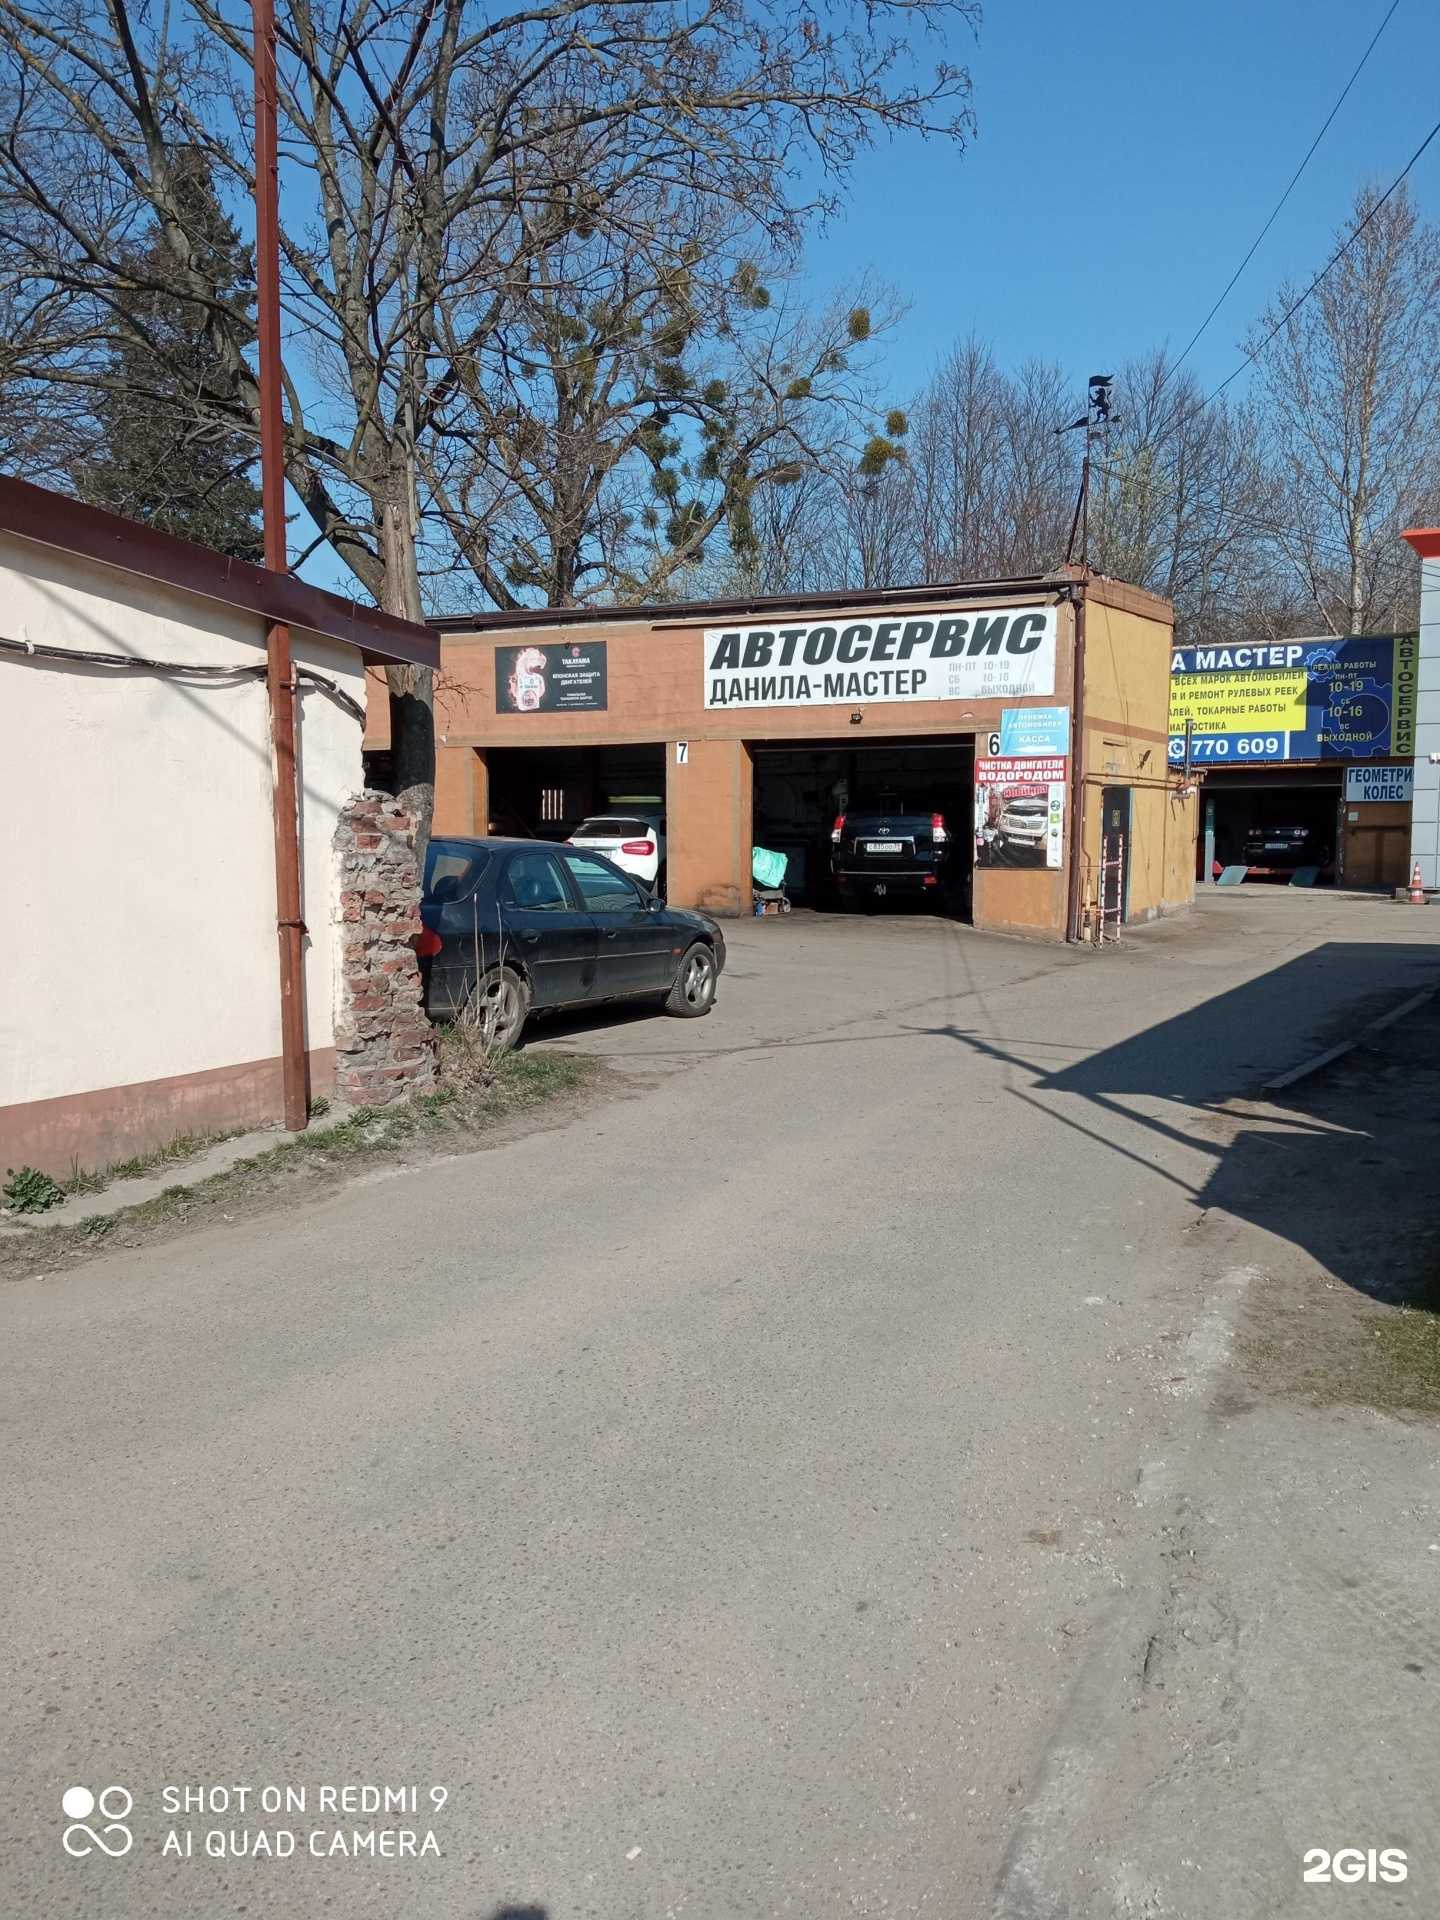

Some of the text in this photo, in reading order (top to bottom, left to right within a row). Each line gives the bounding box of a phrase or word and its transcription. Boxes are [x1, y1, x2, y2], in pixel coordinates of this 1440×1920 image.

[709, 613, 1047, 670] АВТОСЕРВИС
[1196, 646, 1303, 669] МАСТЕР
[1343, 661, 1377, 670] РАБОТЫ
[1175, 670, 1305, 686] ВСЕХ МАРОК АВТОМОБИЛЕЙ
[710, 669, 928, 705] ДАНИЛА-МАСТЕР
[1180, 692, 1186, 700] И
[1189, 690, 1225, 700] РЕМОНТ
[1228, 687, 1271, 698] РУЛЕВЫХ
[1274, 686, 1298, 696] РЕЕК
[1329, 680, 1364, 693] 10-19
[1197, 705, 1245, 715] ТОКАРНЫЕ
[1248, 703, 1286, 713] РАБОТЫ
[1328, 705, 1363, 717] 10-16
[1169, 721, 1226, 732] ИАГОСТИКА
[1019, 735, 1050, 743] КАССА
[1317, 731, 1373, 743] ВЫХОДНОЙ
[989, 733, 1000, 756] 6
[1192, 738, 1279, 755] 770 609
[678, 742, 687, 762] 7
[979, 760, 1064, 771] ЧИСТКА ДВИГАТЕЛЯ
[979, 771, 1064, 782] ВОДОРОДОМ
[1348, 768, 1414, 783] ГЕОМЕТРИ
[1364, 785, 1404, 800] КОЛЕС
